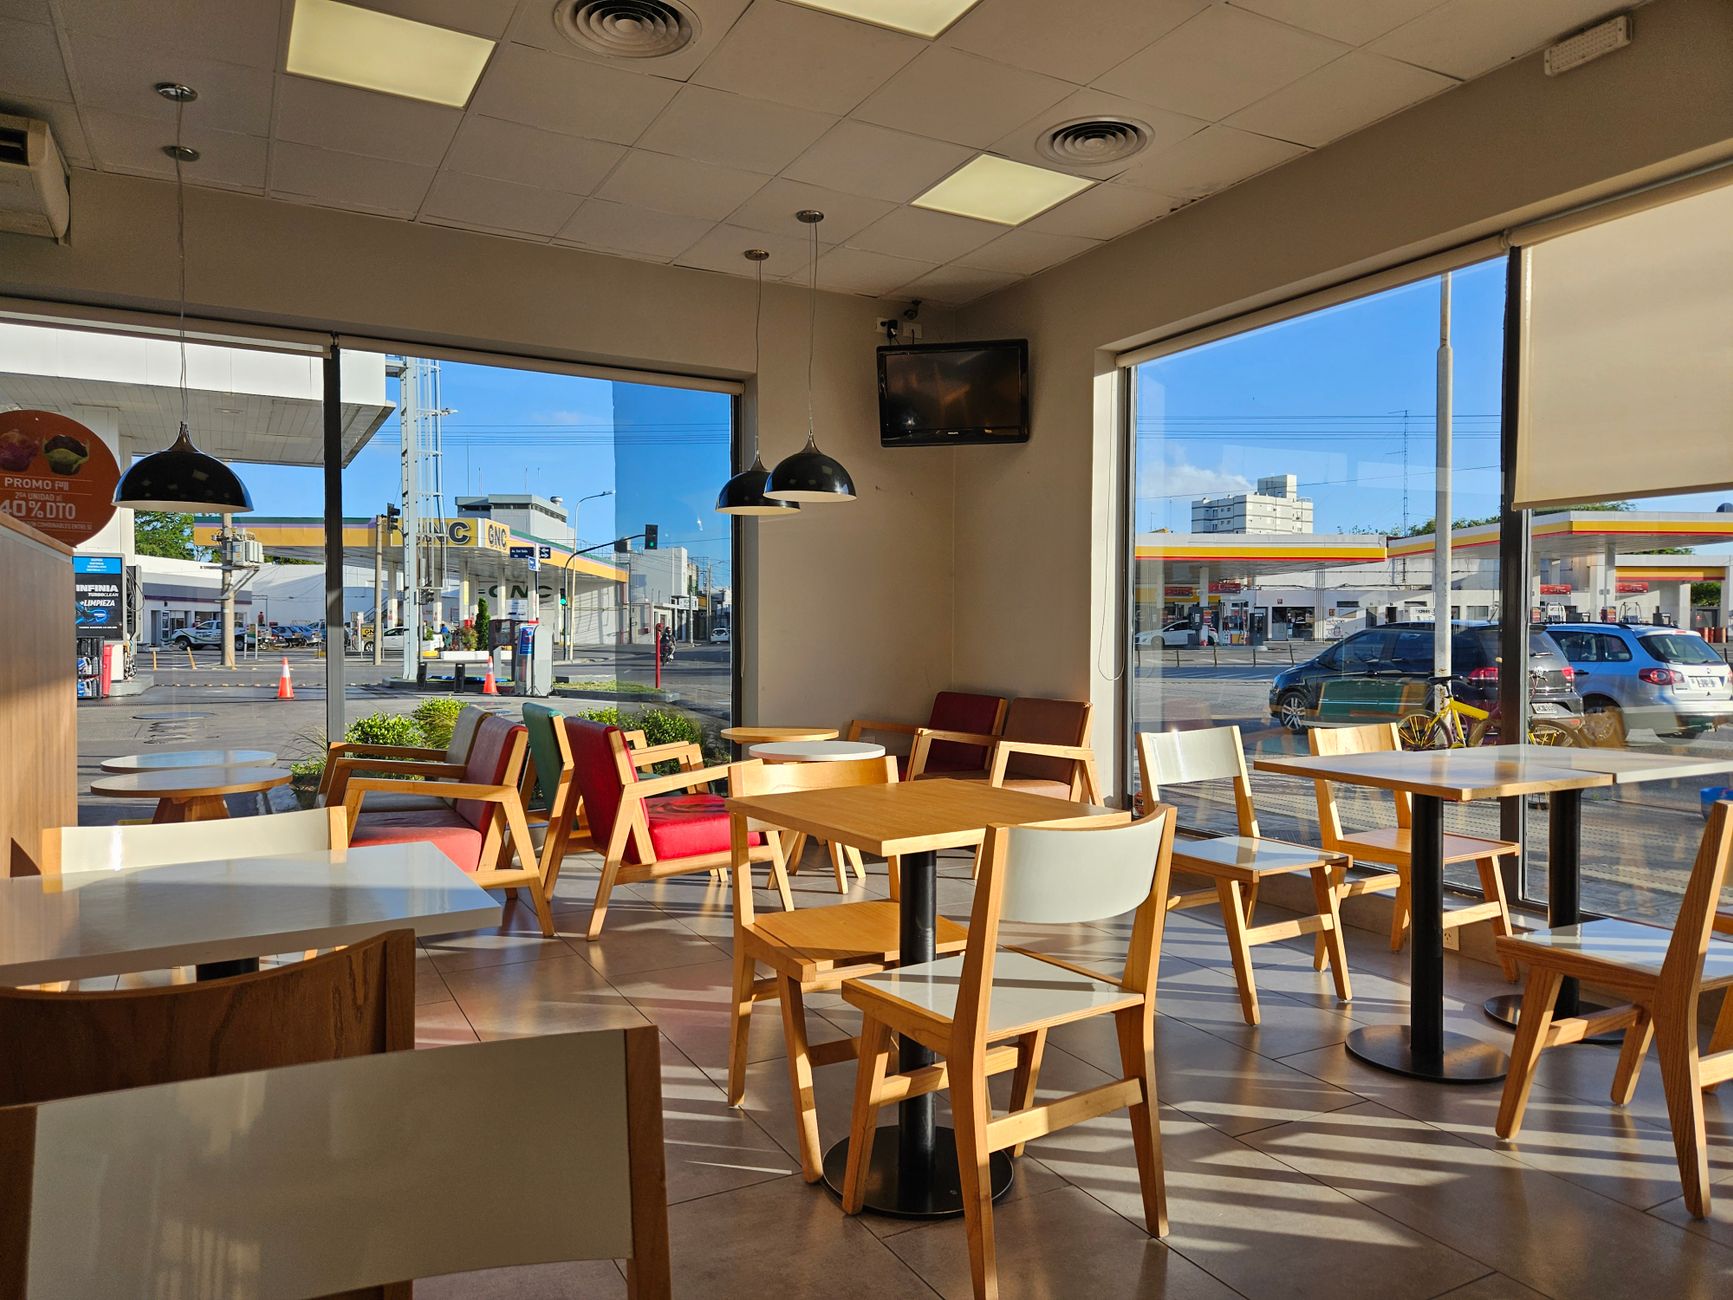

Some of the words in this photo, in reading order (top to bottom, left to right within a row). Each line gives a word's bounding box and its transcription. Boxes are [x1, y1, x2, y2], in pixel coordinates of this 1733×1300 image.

[4, 477, 52, 490] PROMO
[28, 493, 55, 502] UNIDAD
[46, 502, 76, 520] DTO
[488, 524, 507, 547] GNC
[75, 584, 119, 592] INFINIA
